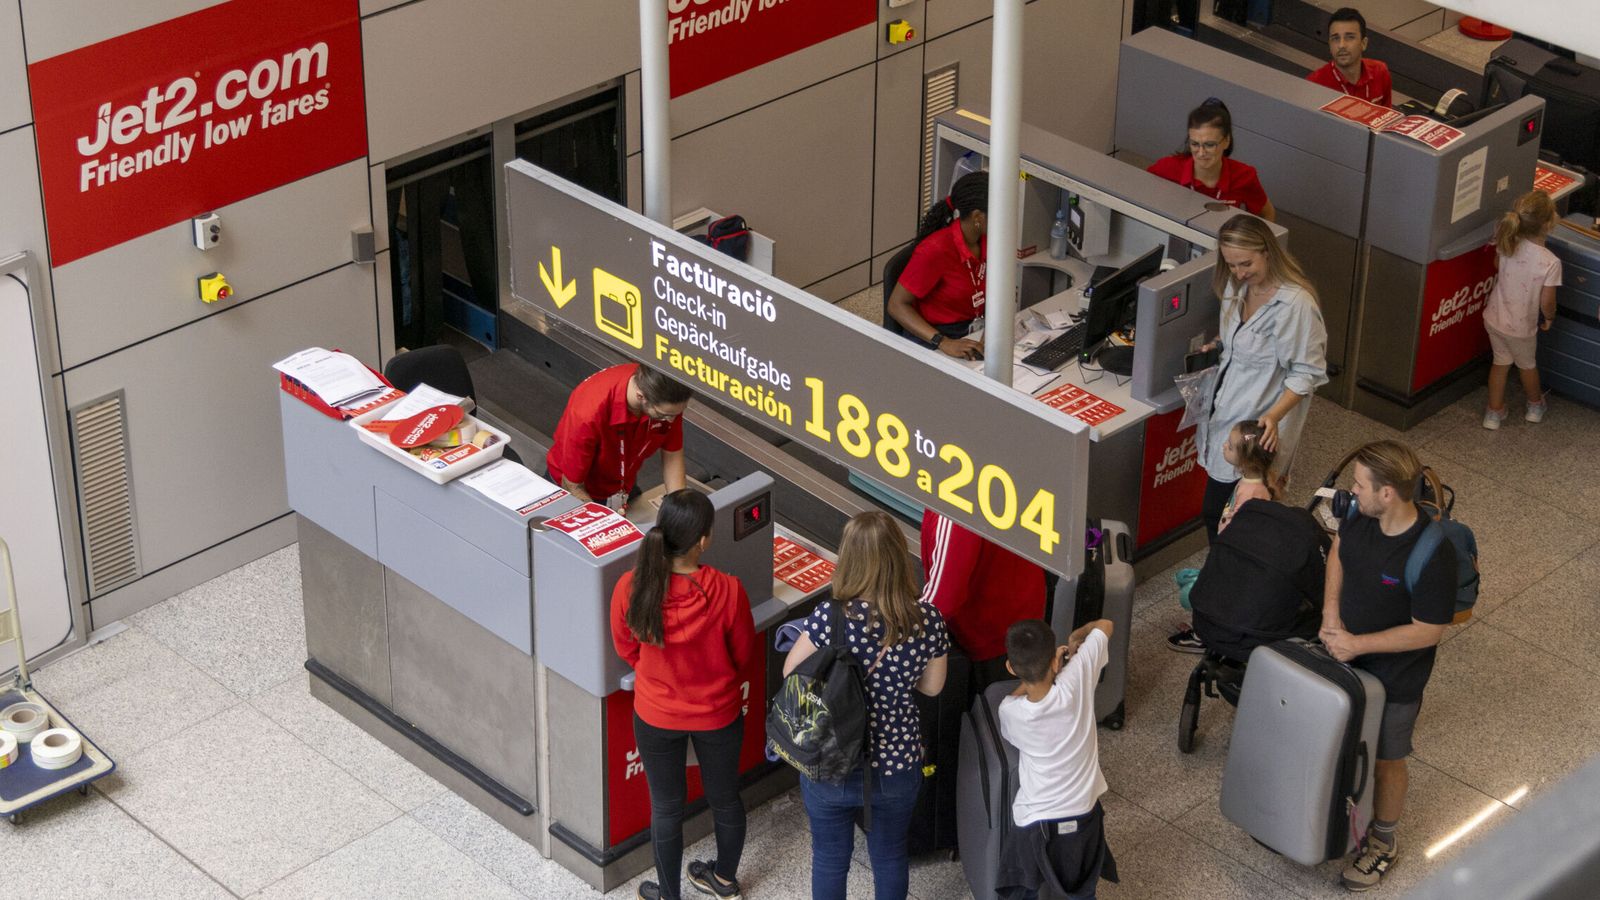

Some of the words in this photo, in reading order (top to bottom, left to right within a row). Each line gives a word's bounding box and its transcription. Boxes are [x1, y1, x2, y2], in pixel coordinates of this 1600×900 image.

[668, 0, 752, 45] Friendly
[77, 42, 329, 156] Jet2.com
[80, 131, 196, 192] Friendly
[204, 114, 252, 149] low
[261, 88, 329, 129] fares
[653, 276, 727, 330] Check-in
[1429, 308, 1466, 337] Friendly
[654, 306, 792, 391] Gepäckaufgabe
[655, 333, 793, 426] Facturación
[805, 377, 911, 478] 188
[914, 429, 936, 458] to
[938, 444, 1060, 555] 204
[1153, 457, 1197, 489] Friendly
[1155, 435, 1197, 472] Jet2
[916, 469, 932, 494] a
[587, 524, 630, 545] Jet2.com
